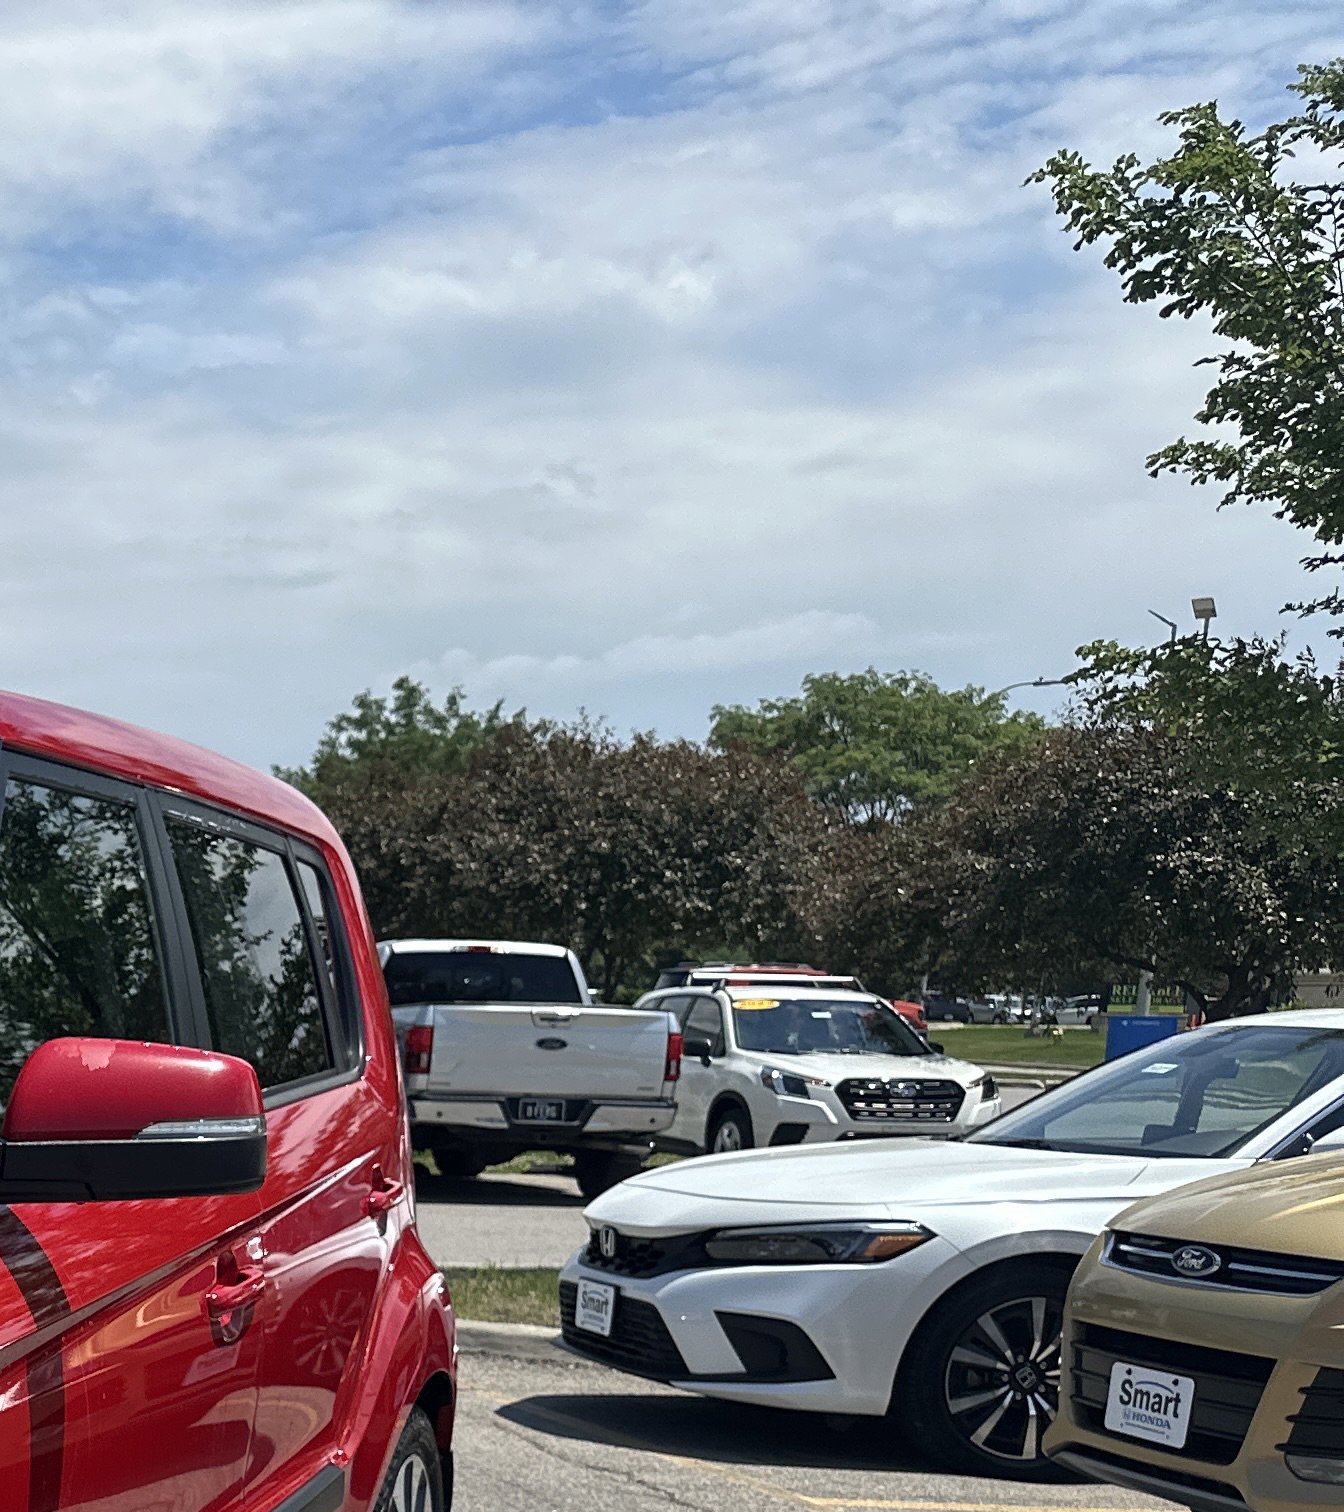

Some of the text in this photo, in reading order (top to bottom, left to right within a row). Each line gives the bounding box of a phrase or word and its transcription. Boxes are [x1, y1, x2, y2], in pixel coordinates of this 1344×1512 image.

[1177, 1249, 1207, 1270] Ford
[1119, 1378, 1182, 1419] Smart
[1132, 1411, 1171, 1430] HONDA
